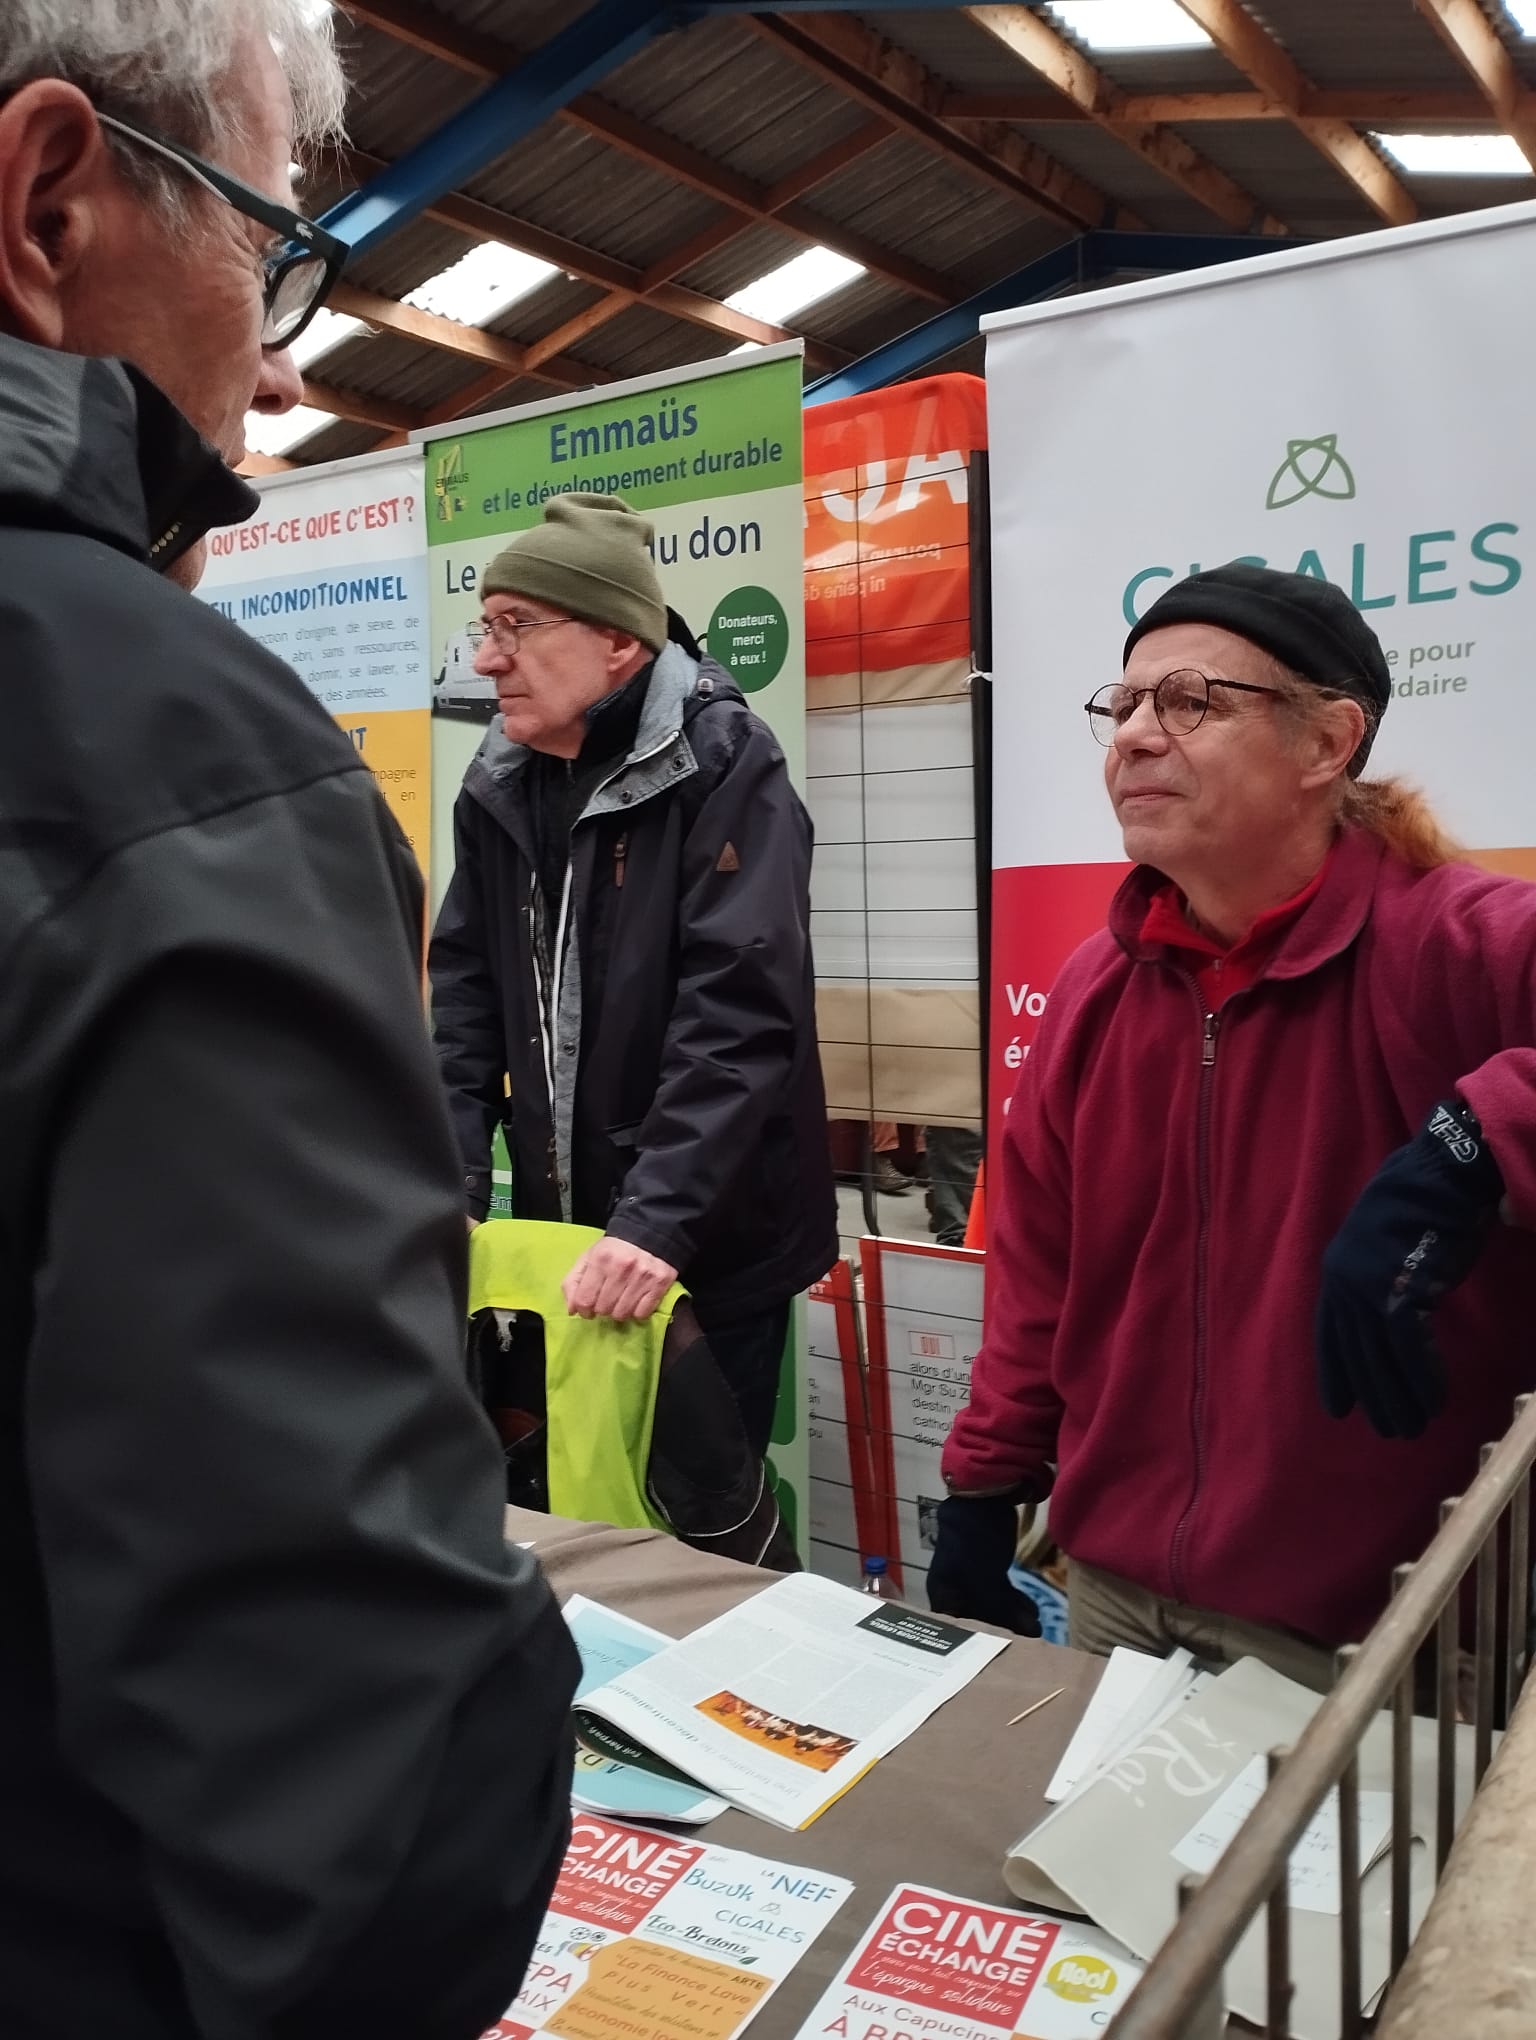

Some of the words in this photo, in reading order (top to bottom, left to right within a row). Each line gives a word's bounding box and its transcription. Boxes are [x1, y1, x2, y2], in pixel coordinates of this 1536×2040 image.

[551, 397, 698, 464] Emmaüs
[482, 494, 501, 514] et
[505, 488, 521, 511] le
[526, 456, 688, 507] développement
[693, 437, 783, 476] durable
[211, 518, 301, 557] QU'EST-CE
[306, 510, 340, 541] QUE
[346, 498, 399, 533] C'EST
[689, 515, 761, 560] don
[446, 559, 476, 595] Le
[242, 576, 409, 620] INCONDITIONNEL
[718, 613, 778, 630] Donateurs,
[732, 631, 765, 647] merci
[406, 662, 420, 674] se
[740, 654, 761, 665] eux
[1409, 641, 1476, 670] pour
[566, 1824, 697, 1881] CINÉ
[771, 1874, 838, 1903] NEF
[714, 1909, 808, 1945] CIGALES
[893, 1901, 1049, 1965] CINÉ
[876, 1931, 1033, 1987] ÉCHANGE
[602, 1970, 651, 1994] Plus
[642, 1964, 708, 1992] Finance
[730, 1974, 766, 1991] ARTE
[842, 1994, 889, 2015] Aux
[939, 1983, 1015, 2016] solidaire
[822, 2009, 849, 2039] À
